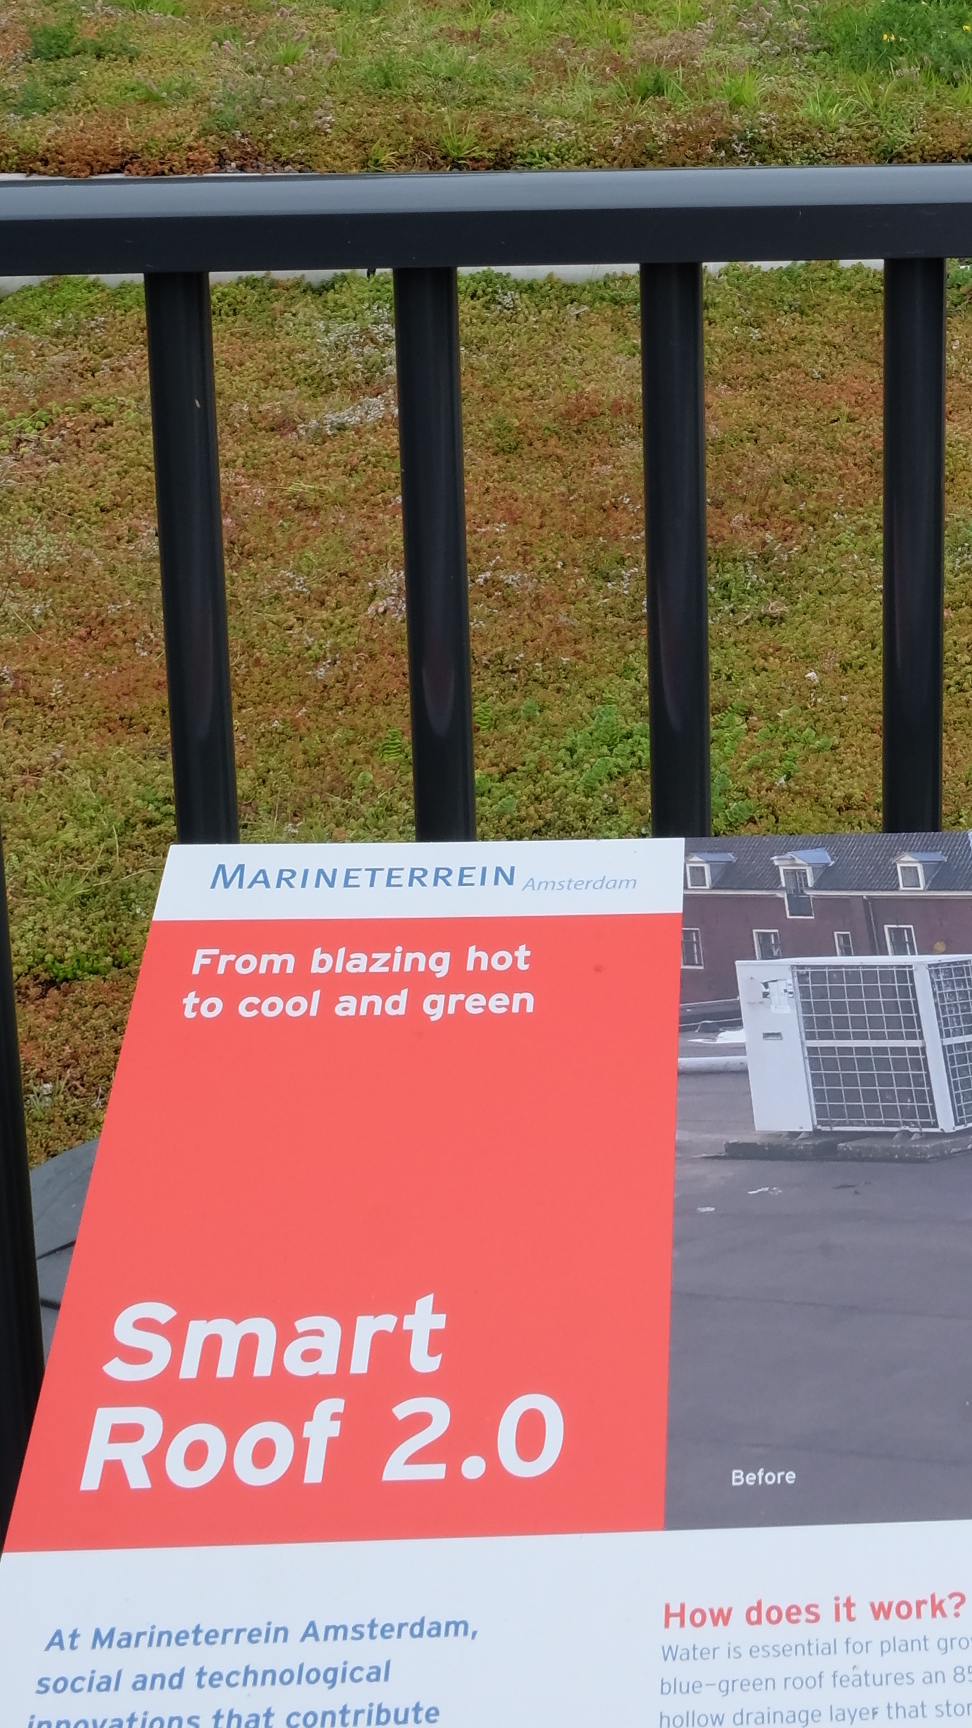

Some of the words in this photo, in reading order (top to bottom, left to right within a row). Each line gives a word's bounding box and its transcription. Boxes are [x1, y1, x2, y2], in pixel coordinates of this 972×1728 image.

[210, 864, 515, 889] MARINETERREIN
[522, 876, 636, 891] Amsterdam
[192, 949, 295, 974] From
[311, 946, 450, 978] blazing
[467, 944, 531, 971] hot
[183, 991, 223, 1018] to
[238, 990, 320, 1017] cool
[335, 988, 408, 1016] and
[423, 992, 534, 1021] green
[103, 1294, 446, 1380] Smart
[81, 1398, 344, 1490] Roof
[383, 1393, 563, 1480] 2.0
[732, 1468, 796, 1486] Before
[664, 1602, 733, 1629] How
[746, 1599, 820, 1626] does
[834, 1596, 856, 1622] it
[870, 1592, 966, 1621] work?
[44, 1628, 80, 1651] At
[91, 1621, 288, 1650] Marineterrein
[300, 1616, 477, 1642] Amsterdam,
[662, 1644, 720, 1662] Water
[728, 1642, 742, 1659] is
[749, 1638, 836, 1658] essential
[845, 1637, 872, 1654] for
[881, 1635, 929, 1657] plant
[35, 1669, 122, 1694] social
[132, 1667, 185, 1691] and
[196, 1660, 391, 1690] technological
[784, 1671, 824, 1690] roof
[832, 1667, 914, 1688] features
[922, 1671, 945, 1684] an
[212, 1707, 275, 1728] that
[286, 1701, 439, 1728] contribute
[660, 1710, 725, 1728] hollow
[733, 1707, 821, 1727] drainage
[887, 1701, 927, 1719] that
